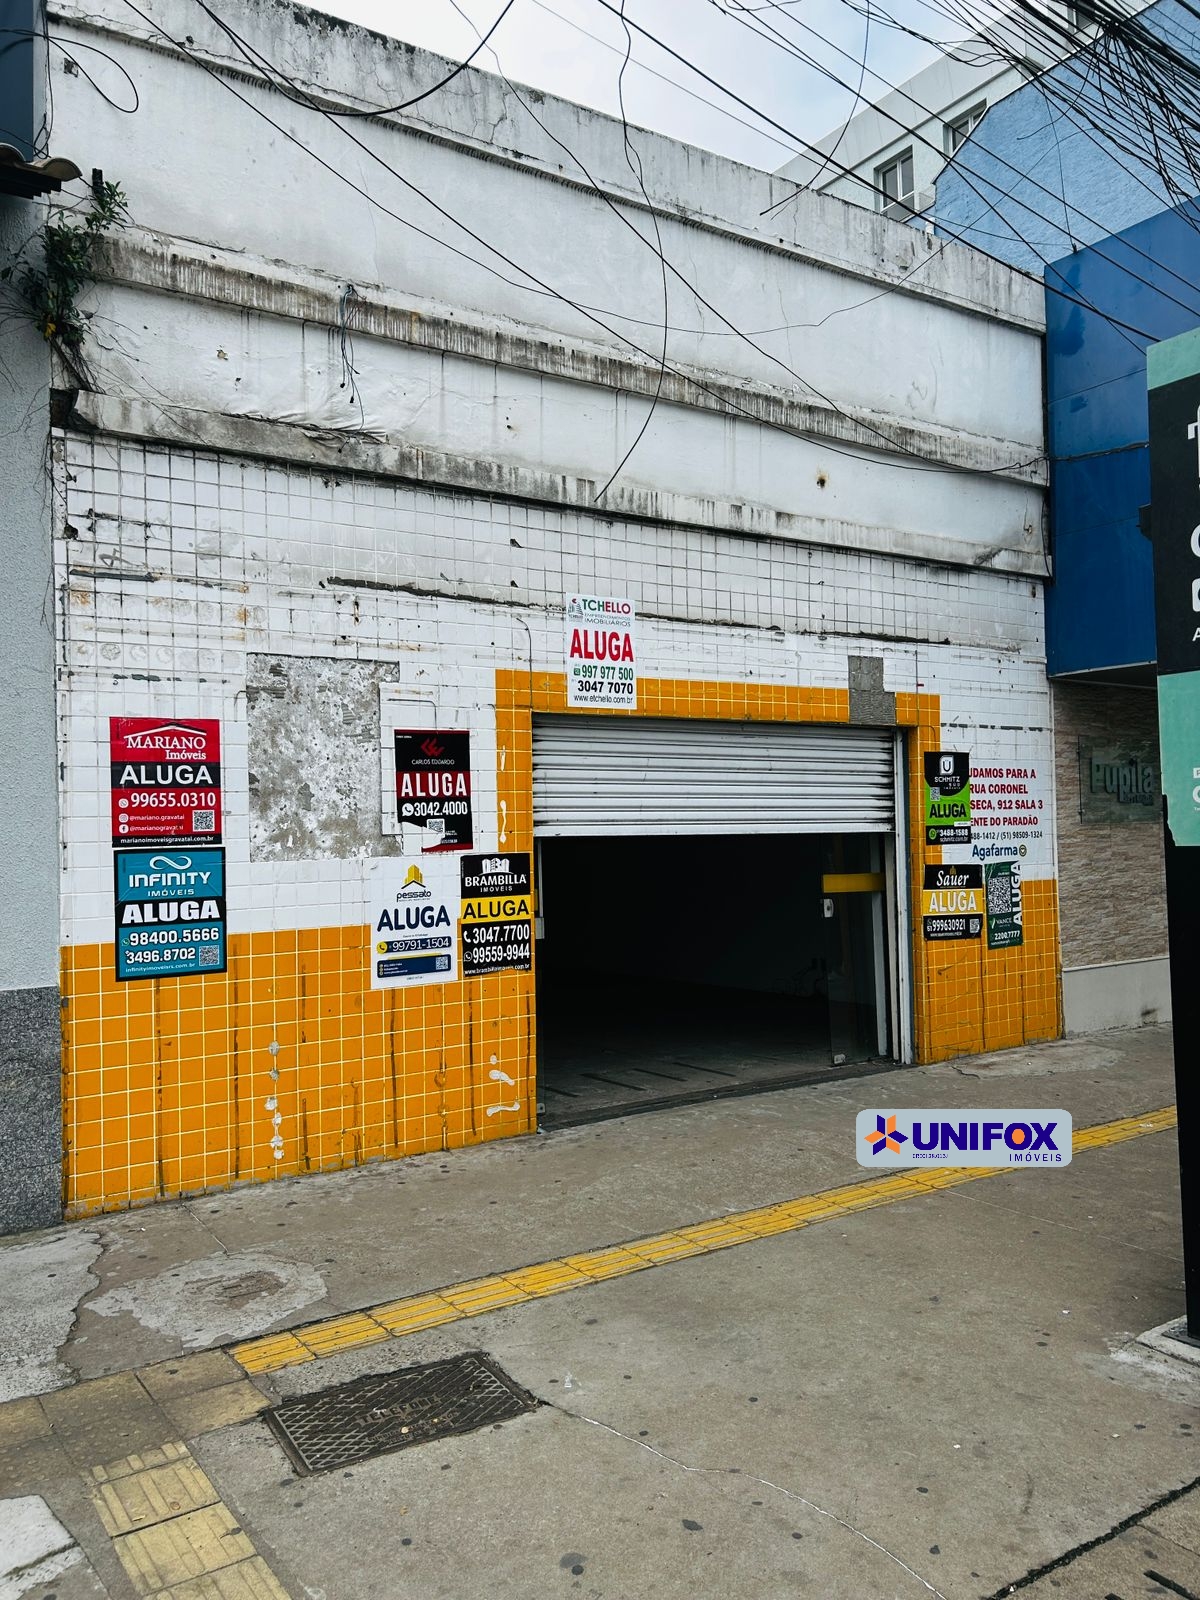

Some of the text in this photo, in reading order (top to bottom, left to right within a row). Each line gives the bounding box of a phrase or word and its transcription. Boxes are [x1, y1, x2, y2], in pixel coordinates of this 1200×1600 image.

[570, 629, 634, 662] ALUGA
[582, 665, 634, 681] 997 977 500
[578, 680, 633, 694] 3047 7070
[127, 735, 206, 749] MARIANO
[166, 750, 207, 760] Imóveis
[120, 765, 213, 785] ALUGA
[969, 768, 1036, 779] UDAMOS PARA A
[401, 773, 467, 797] ALUGA
[970, 783, 1028, 794] RUA CORONEL
[131, 792, 216, 808] 99655.0310
[971, 800, 1043, 811] SECA, 912 SALA 3
[415, 801, 468, 816] 3042.4000
[930, 803, 967, 819] ALUGA
[130, 814, 185, 823] @mariano.gravatai
[990, 817, 1001, 826] DO
[1003, 815, 1039, 826] PARADÃO
[121, 836, 214, 844] marianoimoveisgravatai.com.br
[1001, 832, 1012, 840] (51)
[972, 843, 1018, 861] Agafarma
[129, 872, 211, 888] INFINITY
[465, 875, 527, 887] BRAMBILLA
[937, 870, 969, 886] Sauer
[148, 889, 195, 897] IMÓVEIS
[397, 890, 432, 902] pessato
[1011, 861, 1022, 926] ALUGA
[463, 900, 529, 919] ALUGA
[930, 891, 977, 912] ALUGA
[122, 900, 221, 924] ALUGA
[377, 905, 451, 932] ALUGA
[932, 919, 966, 931] 999630921
[130, 928, 219, 946] 98400.5666
[473, 924, 529, 944] 3047.7700
[393, 938, 449, 952] 99791-1504
[127, 948, 196, 964] 3496.8702
[473, 943, 530, 964] 99559-9944
